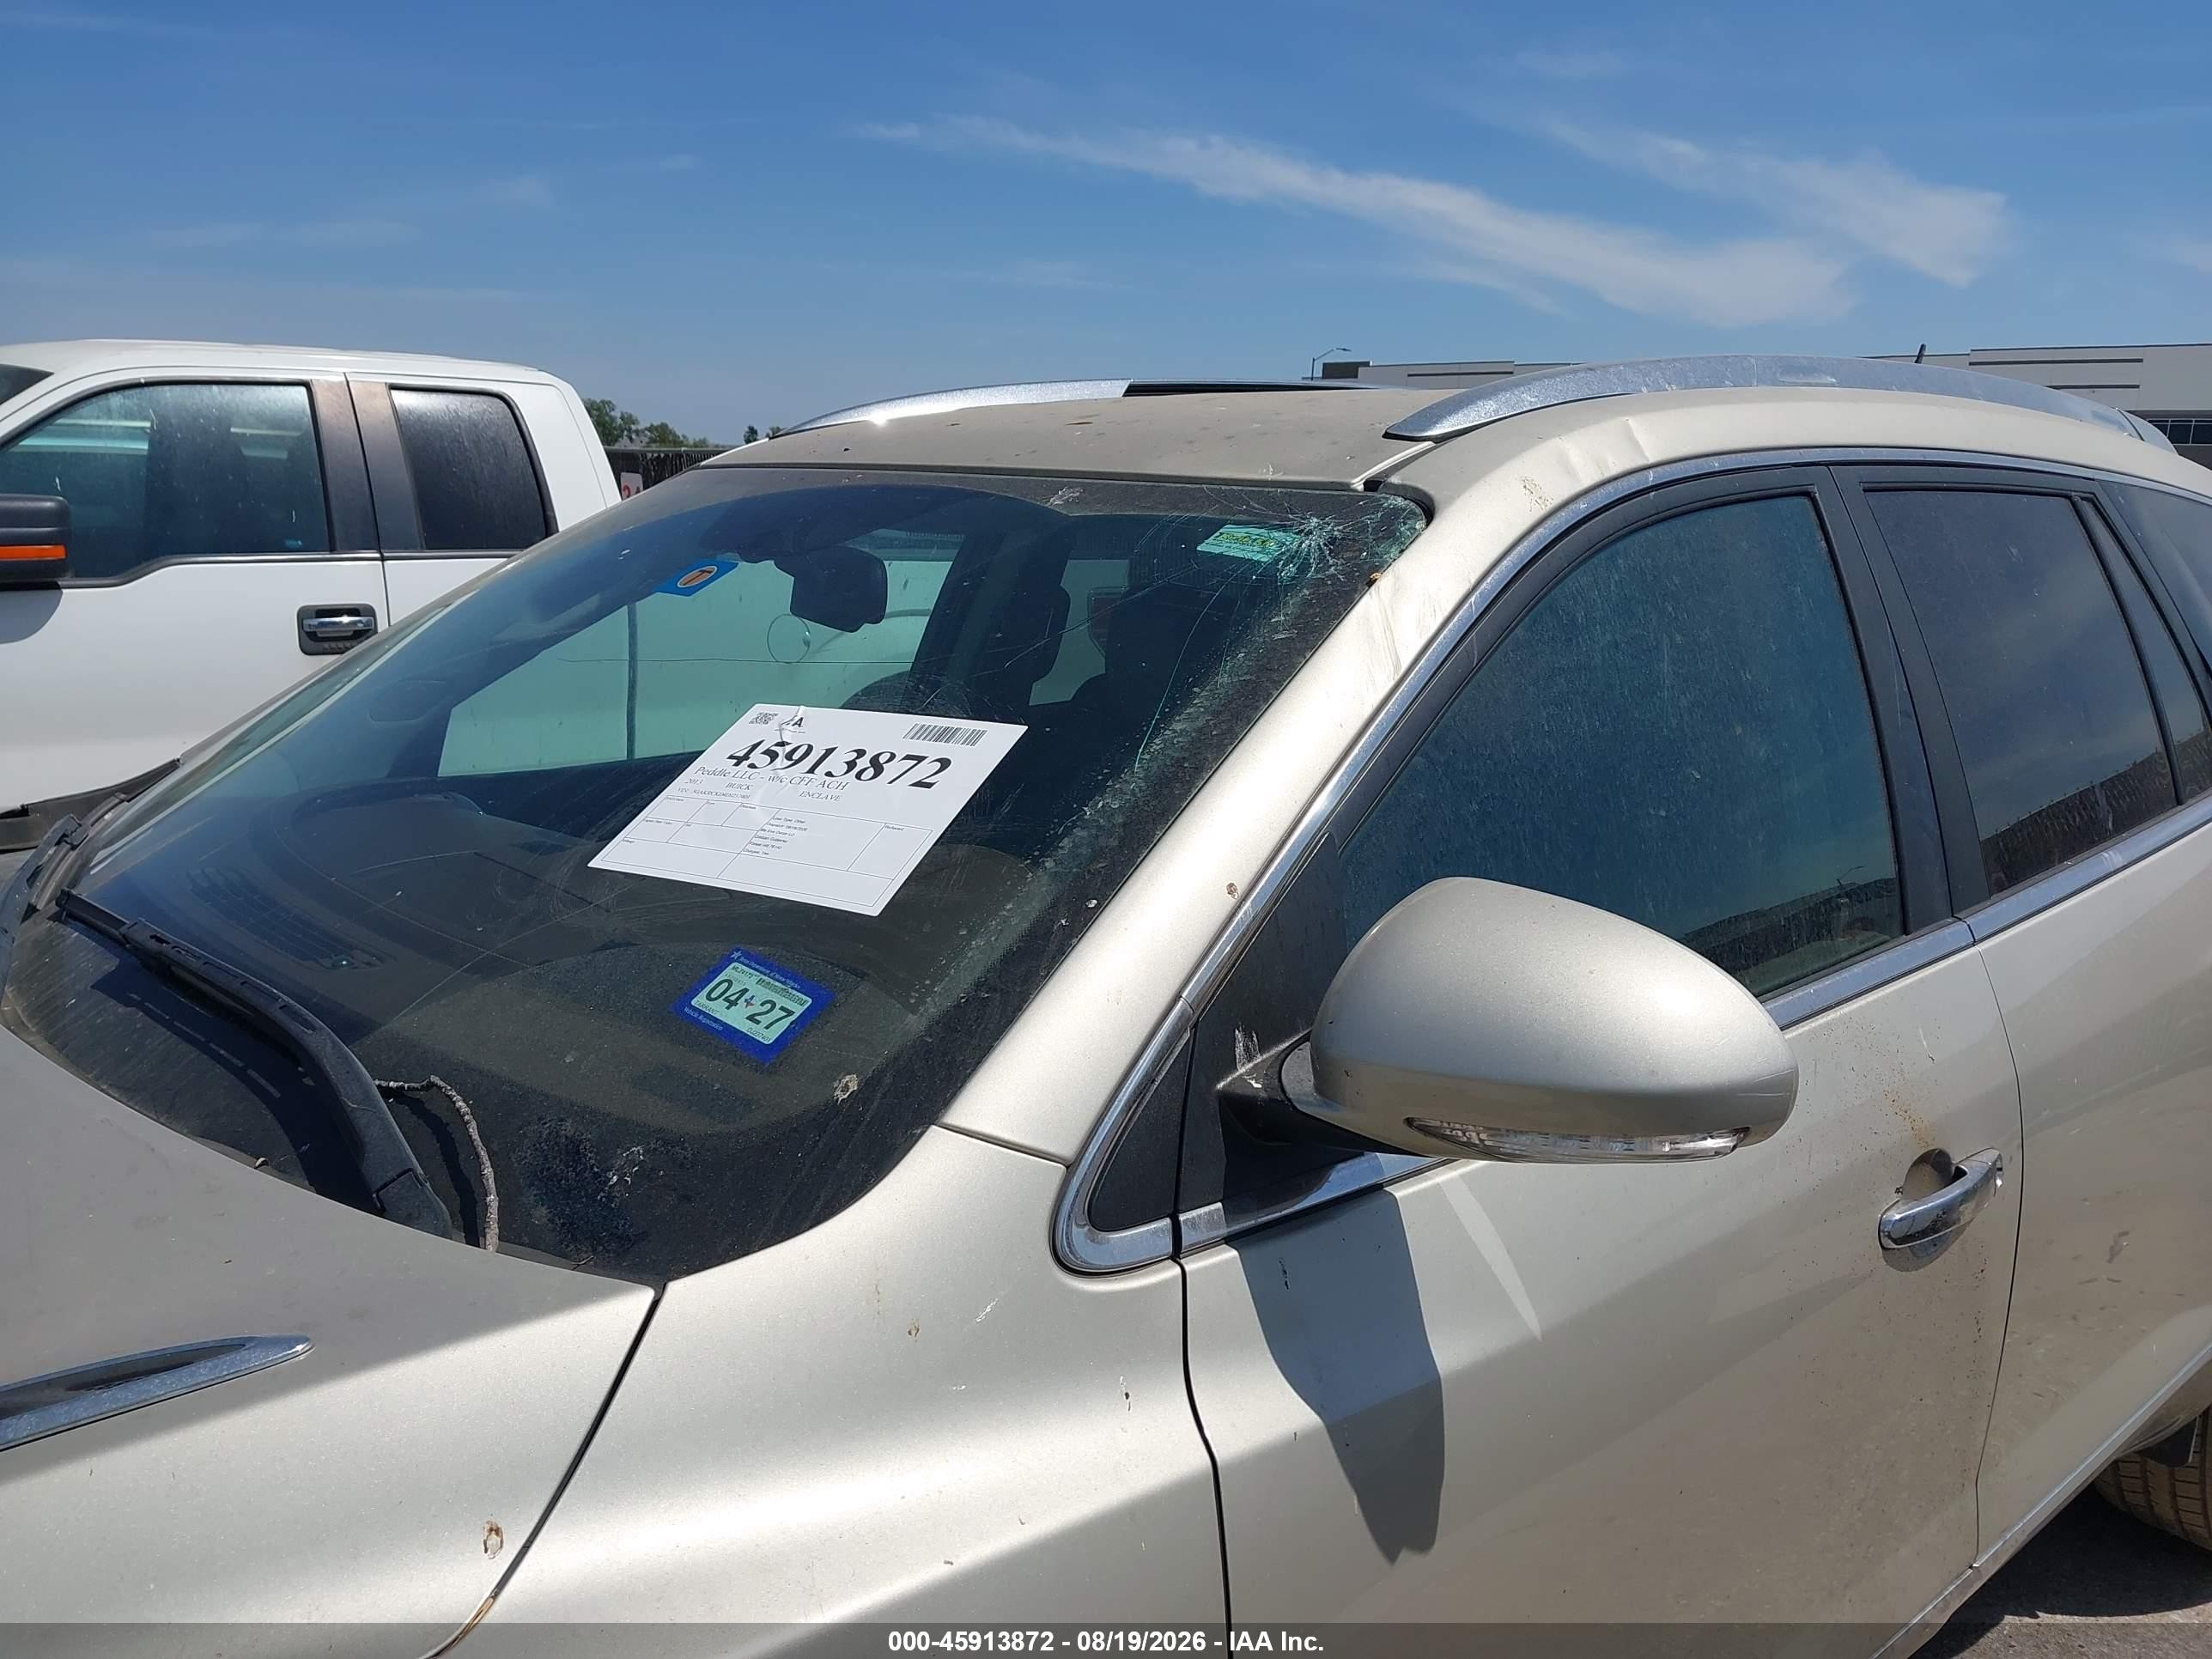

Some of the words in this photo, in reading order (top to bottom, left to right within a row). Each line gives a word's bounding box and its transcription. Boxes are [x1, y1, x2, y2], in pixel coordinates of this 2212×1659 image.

[726, 738, 951, 789] 45913872
[694, 766, 731, 777] Peddle
[732, 769, 760, 781] LLC
[789, 775, 817, 787] CFF
[816, 779, 850, 791] ACH
[799, 790, 842, 802] ENCLAVE
[694, 1000, 720, 1016] TARRANT
[705, 978, 750, 1011] 04
[745, 999, 795, 1030] 27
